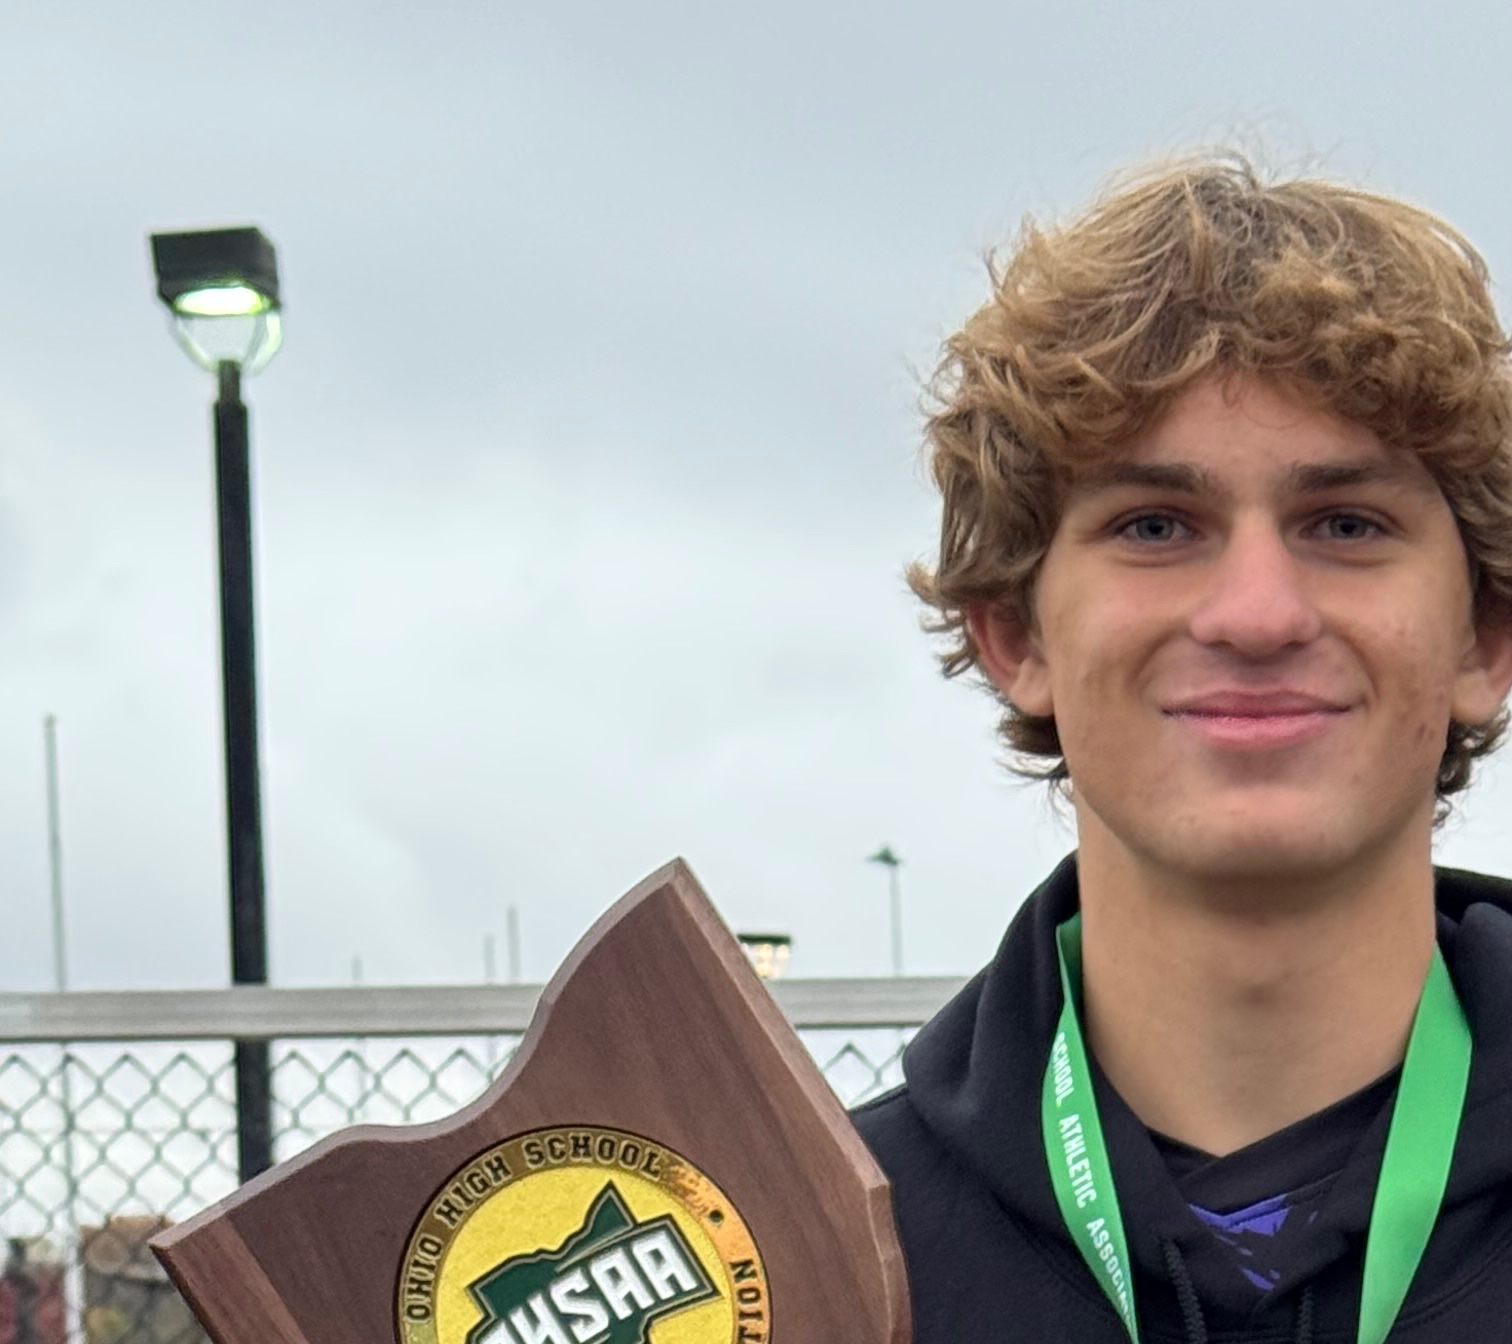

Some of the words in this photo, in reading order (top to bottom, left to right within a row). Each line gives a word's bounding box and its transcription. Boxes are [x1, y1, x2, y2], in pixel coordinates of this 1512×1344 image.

[406, 1233, 443, 1324] OHIO
[435, 1154, 511, 1229] HIGH
[524, 1134, 661, 1177] SCHOOL
[1059, 1114, 1097, 1209] ATHLETIC
